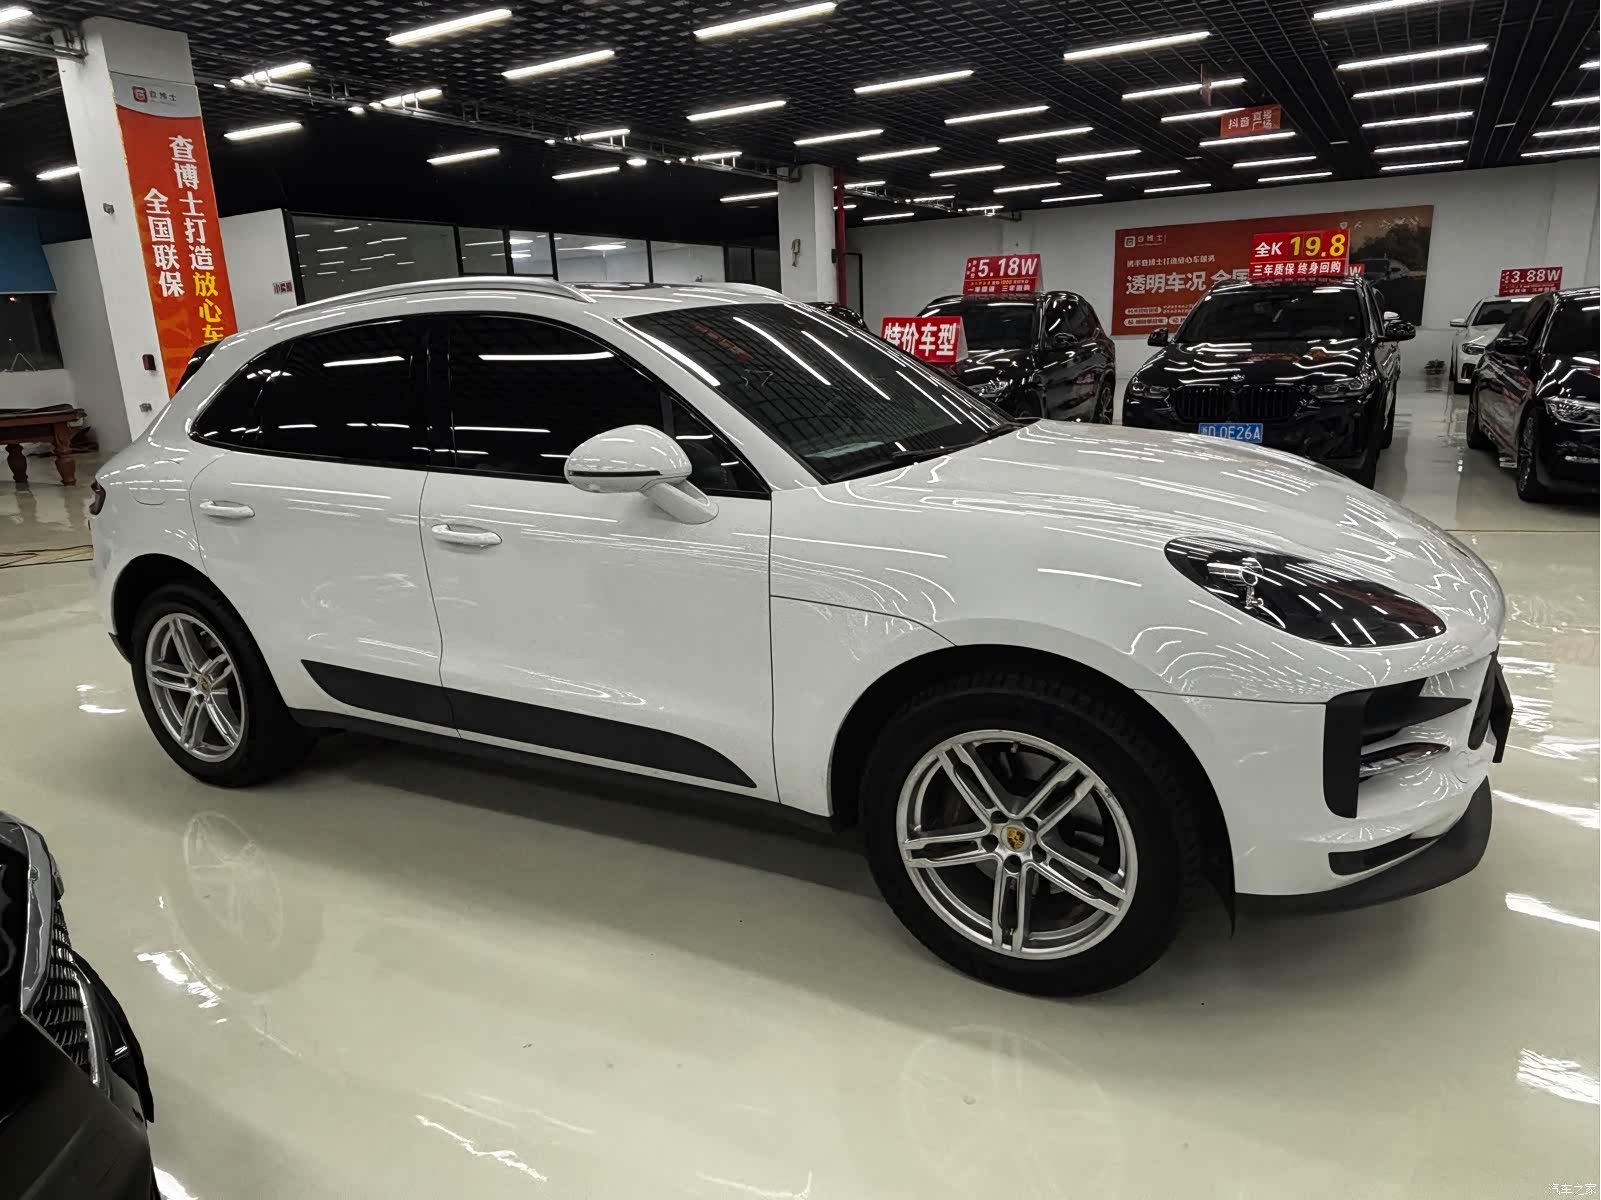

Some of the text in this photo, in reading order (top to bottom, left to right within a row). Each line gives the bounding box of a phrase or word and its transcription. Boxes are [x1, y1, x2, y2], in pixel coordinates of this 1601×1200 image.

[144, 187, 186, 298] 全国联保
[1254, 233, 1346, 258] 全K 19.8
[977, 256, 1038, 278] 5.18W
[1252, 260, 1342, 277] 三年质保 终身回购
[1511, 269, 1561, 283] 3.88W
[1126, 271, 1207, 295] 透明车况
[884, 321, 958, 357] 特价车型
